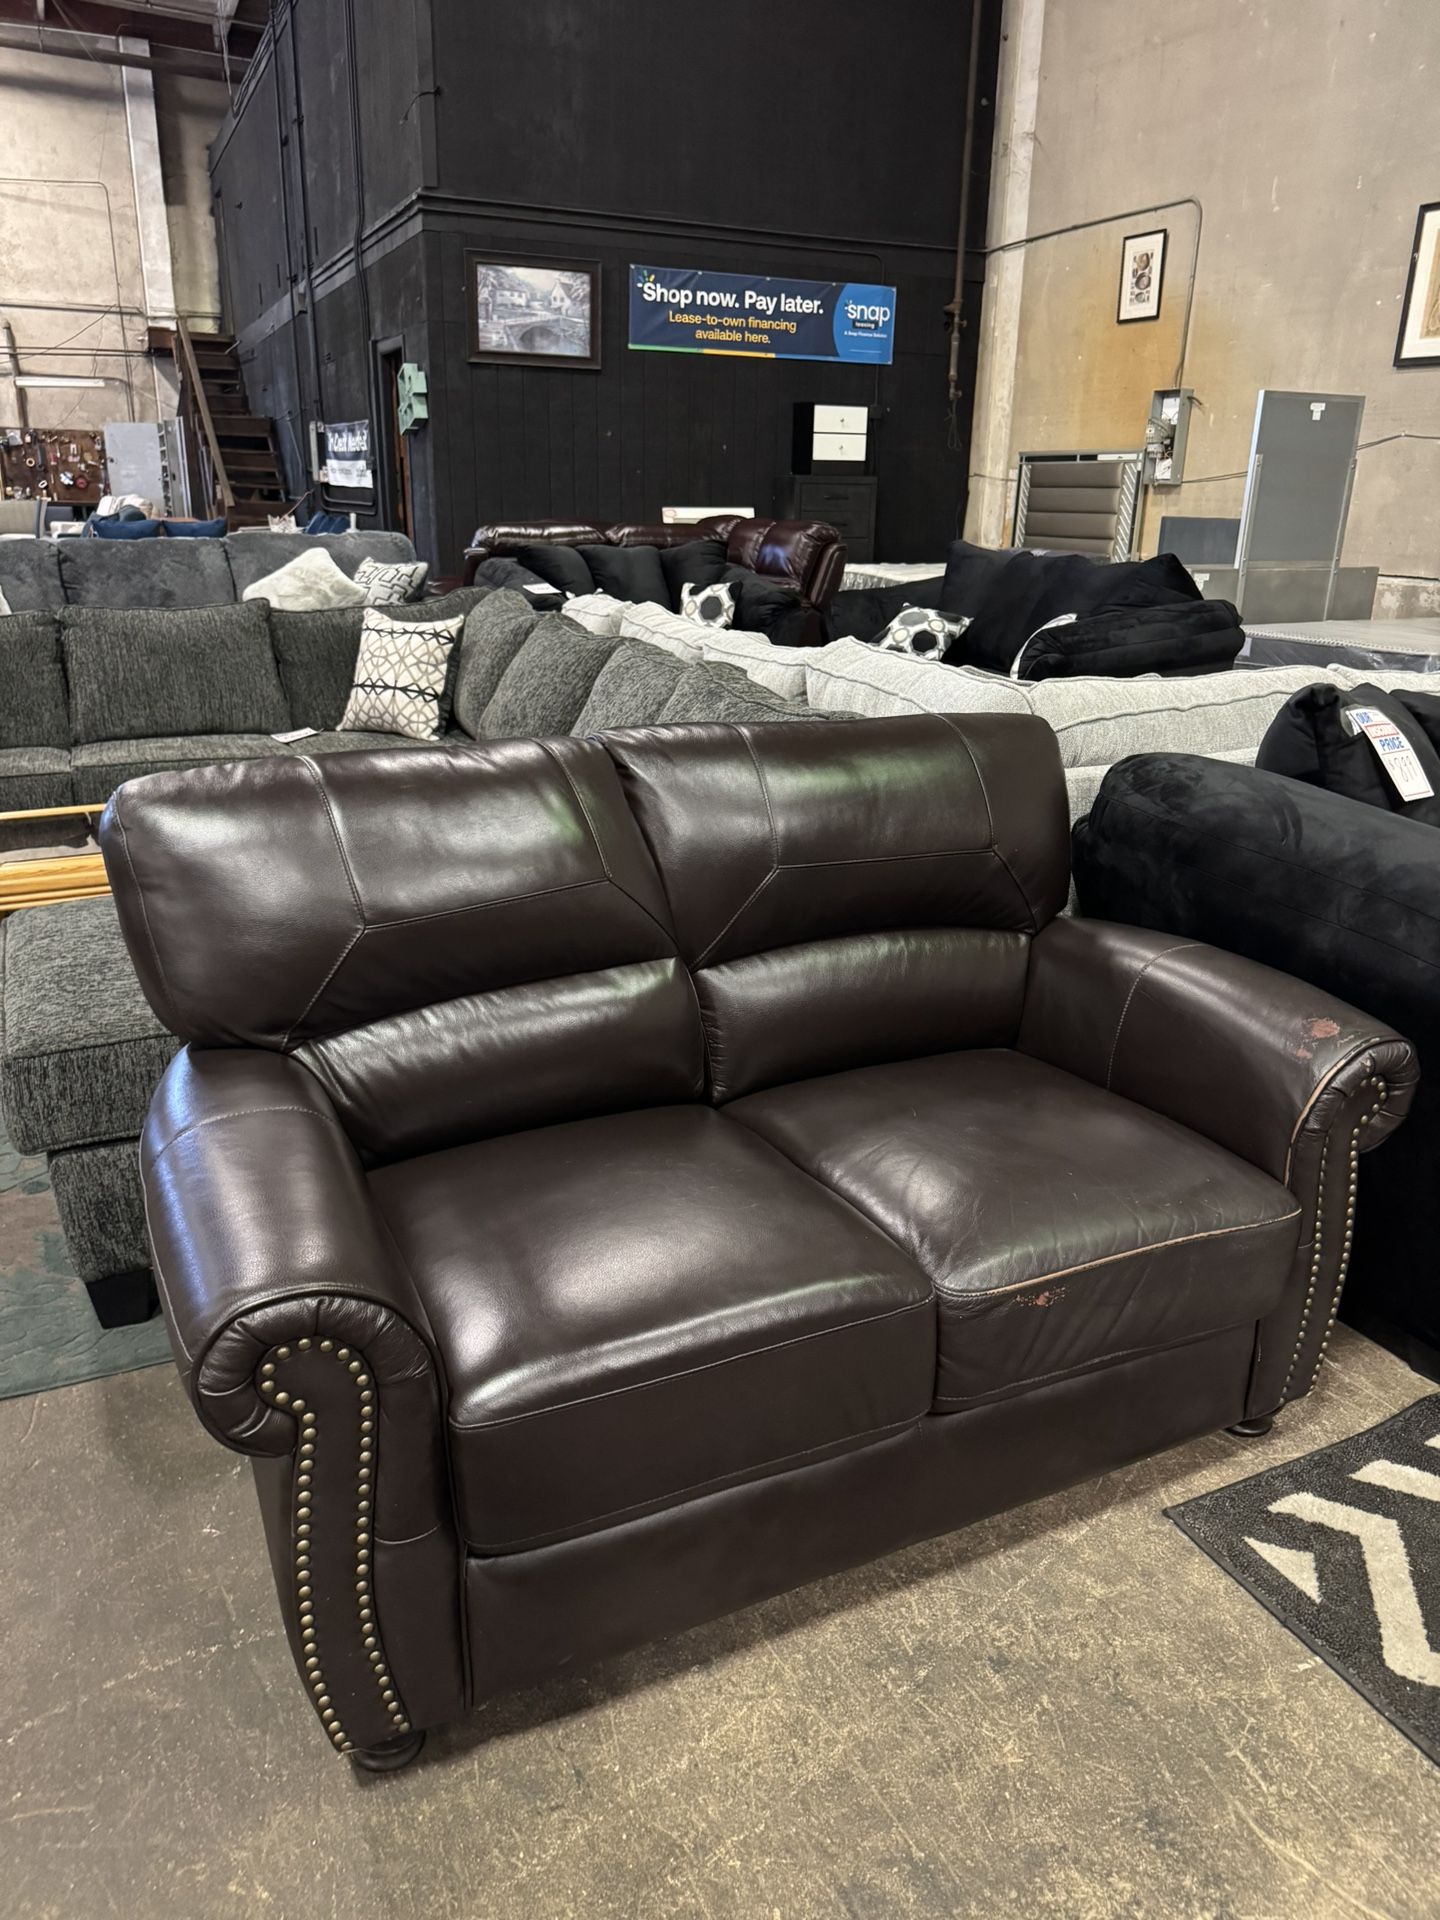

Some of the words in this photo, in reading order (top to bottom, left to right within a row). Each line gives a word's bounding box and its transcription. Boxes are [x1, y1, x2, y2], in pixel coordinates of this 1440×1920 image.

[643, 282, 692, 308] Shop
[696, 291, 739, 308] now.
[744, 291, 777, 315] Pay
[780, 293, 824, 314] later.
[668, 311, 746, 328] Lease-to-own
[748, 316, 796, 333] financing
[847, 304, 890, 327] snap
[695, 329, 742, 343] available
[744, 331, 771, 344] here.
[1355, 712, 1372, 723] OUR
[1379, 737, 1405, 751] PRICE
